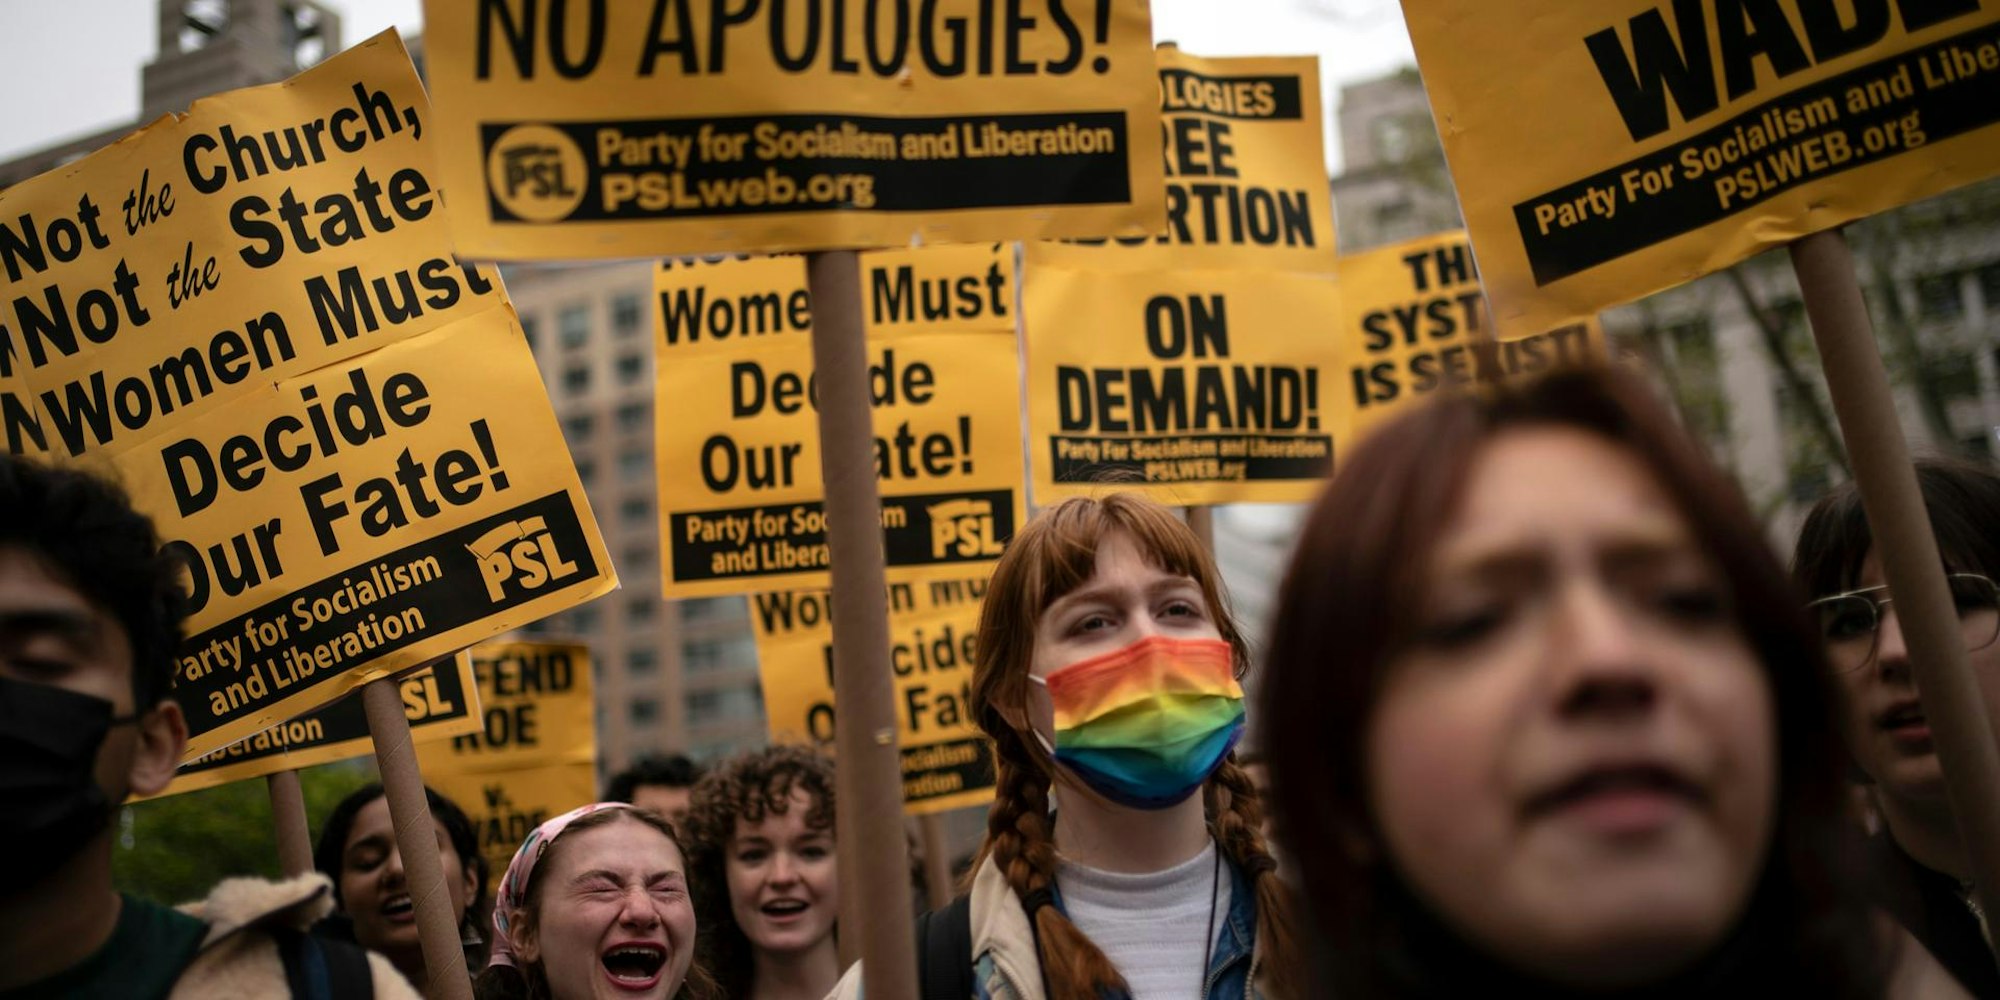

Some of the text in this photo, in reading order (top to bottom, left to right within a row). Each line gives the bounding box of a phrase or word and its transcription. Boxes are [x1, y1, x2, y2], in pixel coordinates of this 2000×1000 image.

[474, 0, 1114, 81] NO APOLOGIES!
[1159, 75, 1276, 117] LOGIES
[597, 121, 1115, 168] Party for Socialism and Liberation
[1161, 117, 1239, 178] EE
[1534, 36, 2000, 236] Party For Socialism and Libe
[1714, 109, 1928, 210] PSLWEB.org
[0, 81, 422, 284] Not the Church,
[504, 158, 577, 199] PSL
[603, 168, 877, 213] PSLweb.org
[13, 258, 150, 369] Not
[166, 241, 221, 310] the
[229, 165, 446, 270] State
[1403, 246, 1479, 291] TH
[660, 262, 1007, 346] Wome Must
[1144, 294, 1230, 360] ON
[1361, 291, 1482, 353] SYST
[40, 311, 296, 458] Women
[303, 254, 493, 347] Must
[730, 349, 936, 421] Dede
[1352, 362, 1400, 408] IS
[1056, 365, 1321, 432] DEMAND!
[161, 367, 432, 519] Decide
[700, 415, 975, 494] Our ate!
[1058, 438, 1327, 463] Party For Socialism and Liberation
[299, 418, 510, 557] Fate!
[686, 511, 749, 545] Party
[753, 507, 788, 539] for
[710, 543, 831, 575] and Libera
[930, 514, 1004, 560] PSL
[475, 530, 578, 603] PSL
[245, 598, 289, 654] for
[291, 551, 443, 633] Socialism
[208, 606, 426, 718] and Liberation
[400, 676, 453, 721] SL
[453, 703, 537, 753] OE
